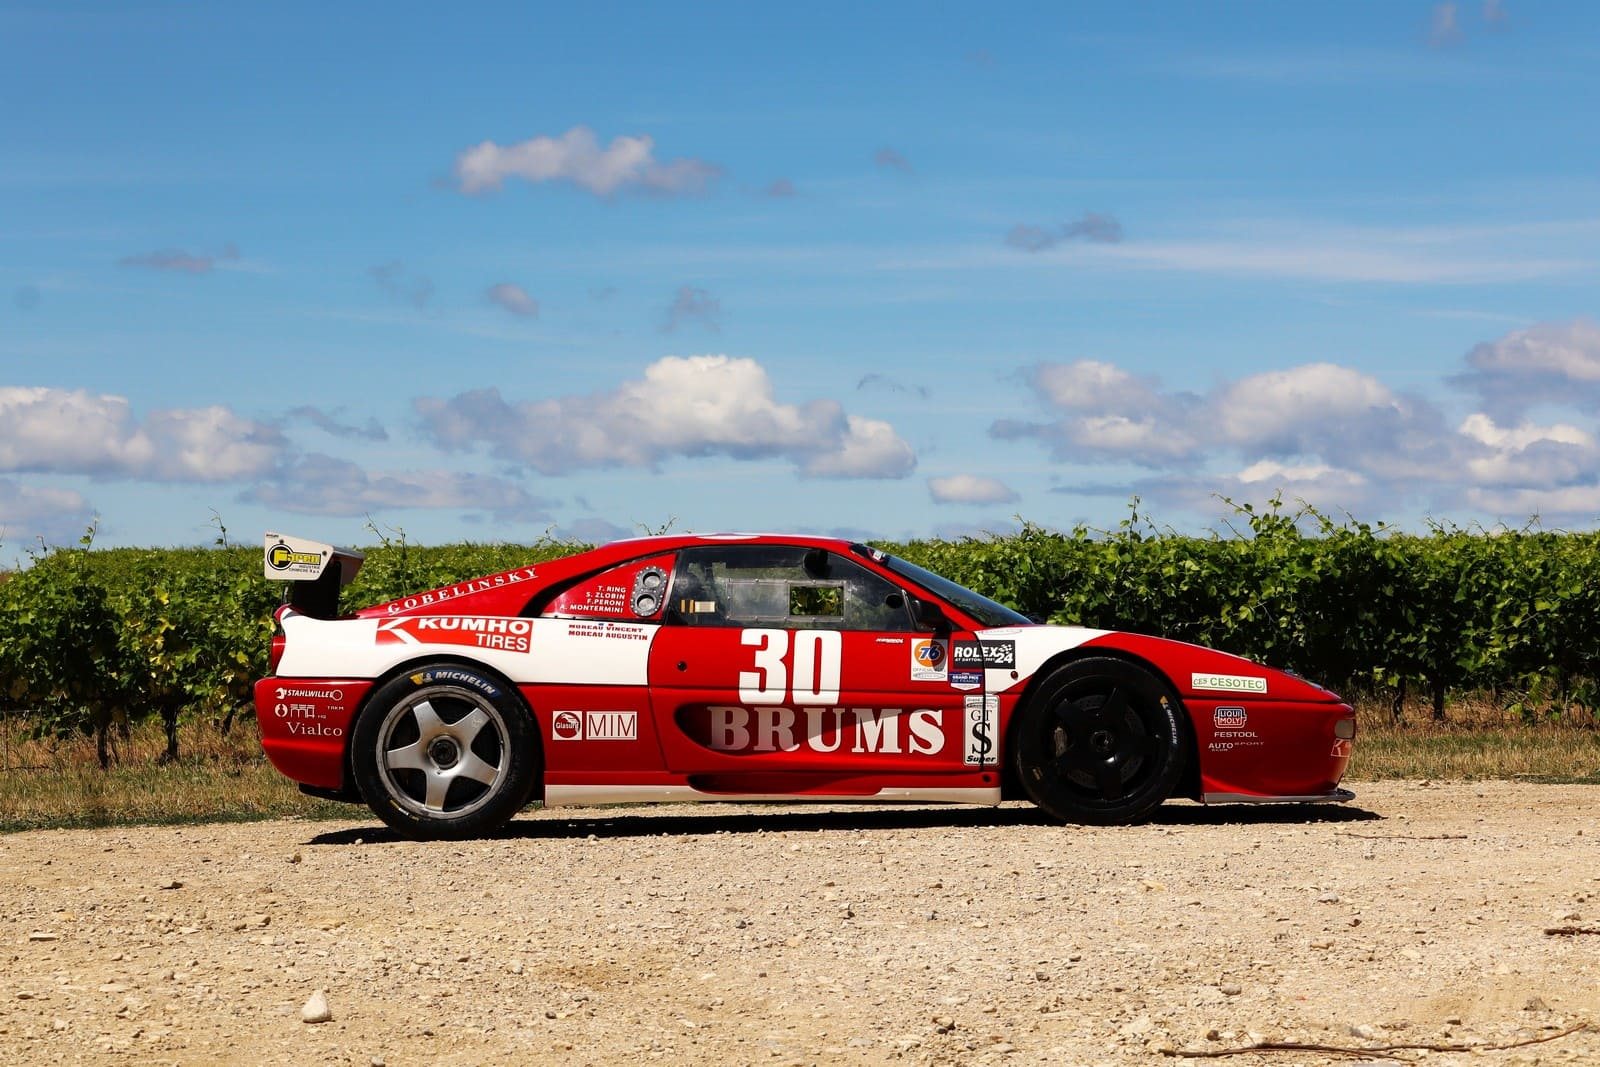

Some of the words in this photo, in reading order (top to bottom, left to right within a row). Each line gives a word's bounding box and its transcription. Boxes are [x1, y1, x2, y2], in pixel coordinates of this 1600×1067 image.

[387, 567, 537, 615] GOBELINSKY
[595, 592, 625, 600] ZLOBIN
[570, 605, 623, 613] MONTERMINI
[417, 617, 530, 634] KUMHO
[606, 625, 644, 633] VINCENT
[475, 633, 528, 651] TIRES
[568, 630, 603, 638] MOREAU
[605, 633, 648, 641] AUGUSTIN
[919, 646, 940, 660] 76
[954, 646, 999, 658] ROLEX
[995, 652, 1014, 664] 24
[738, 628, 842, 705] 30
[435, 671, 496, 694] MICHELIN
[1209, 677, 1263, 689] CESOTEC
[970, 709, 993, 722] GT
[1220, 710, 1241, 718] LIQUI
[286, 721, 343, 737] Vialco
[588, 714, 636, 737] MIM
[706, 705, 945, 755] BRUMS
[1166, 709, 1177, 745] MICHELIN
